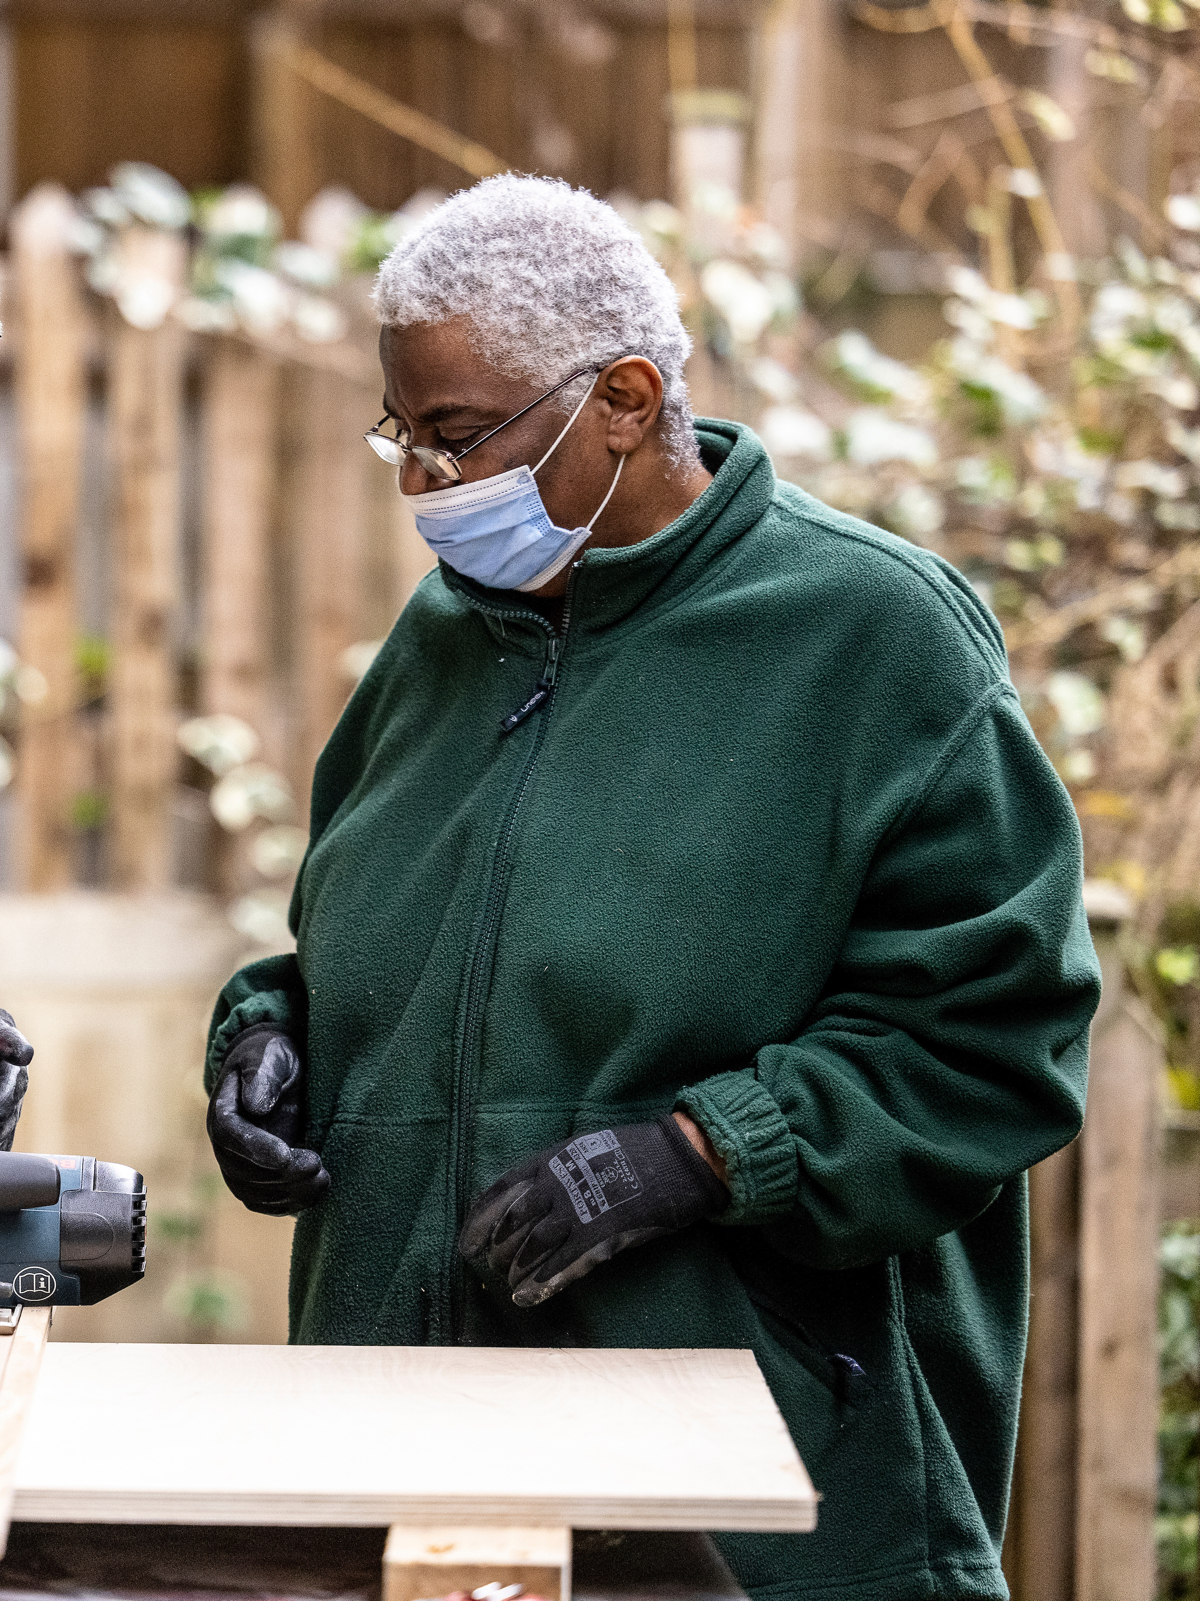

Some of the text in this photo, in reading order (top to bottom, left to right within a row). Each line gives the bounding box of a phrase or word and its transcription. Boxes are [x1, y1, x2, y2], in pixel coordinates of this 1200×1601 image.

[565, 1161, 576, 1172] M
[552, 1162, 588, 1216] PORTWEST
[584, 1190, 592, 1199] 8
